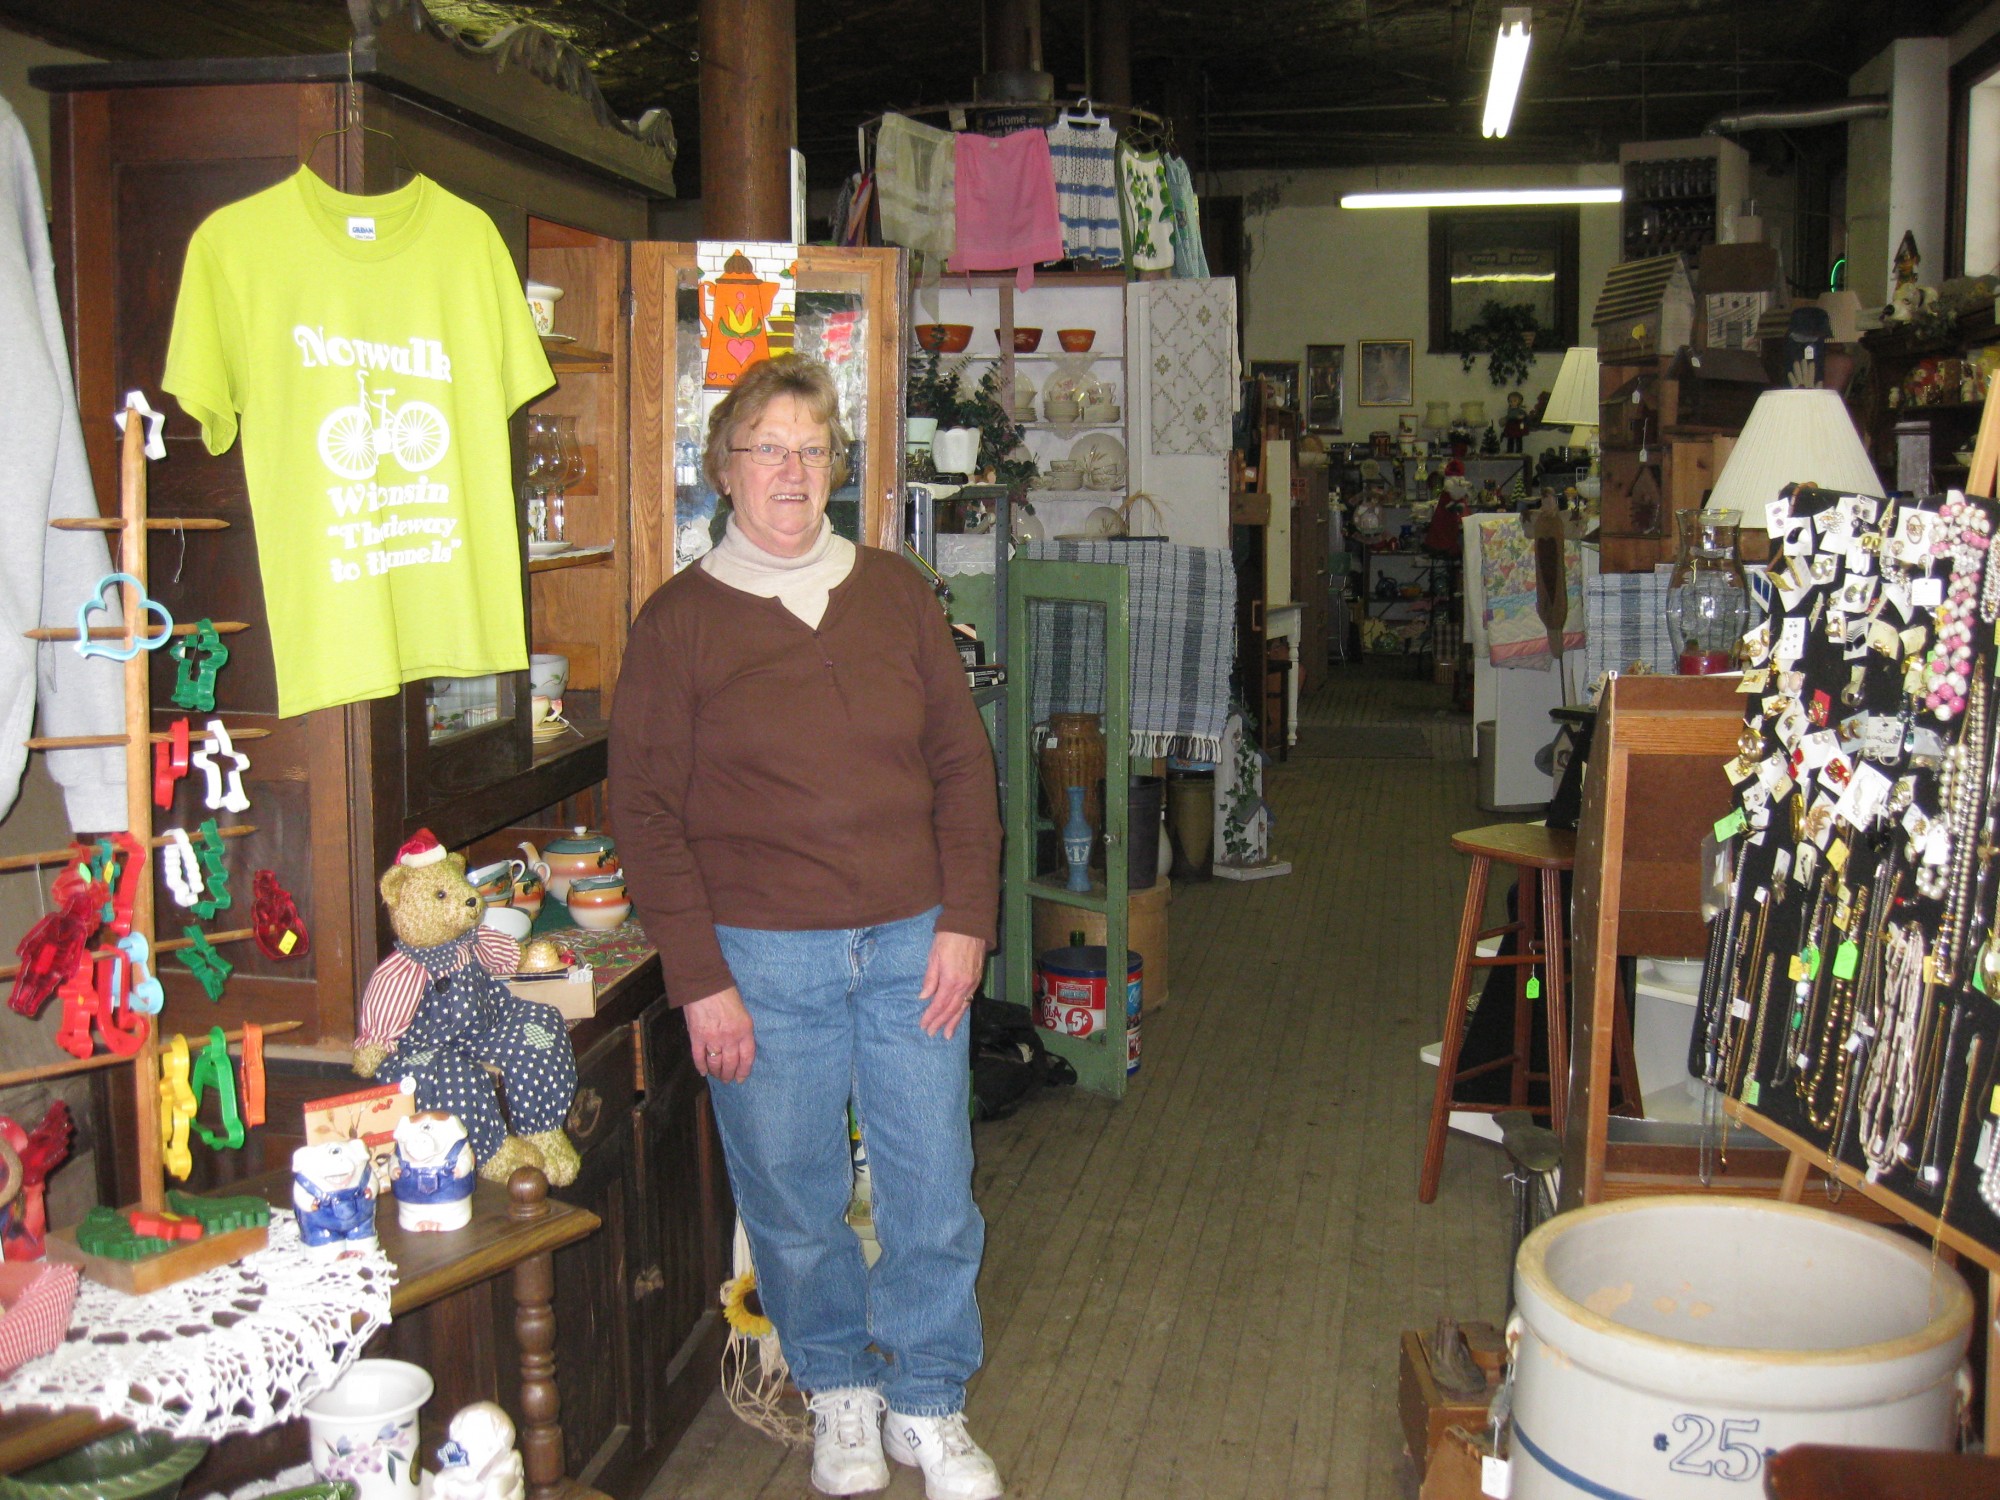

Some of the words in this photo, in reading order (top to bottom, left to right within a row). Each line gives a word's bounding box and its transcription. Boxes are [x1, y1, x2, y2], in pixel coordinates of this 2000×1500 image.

[997, 115, 1026, 126] Home
[292, 324, 452, 383] Norwalk
[329, 558, 361, 583] to
[1669, 1413, 1761, 1482] 25
